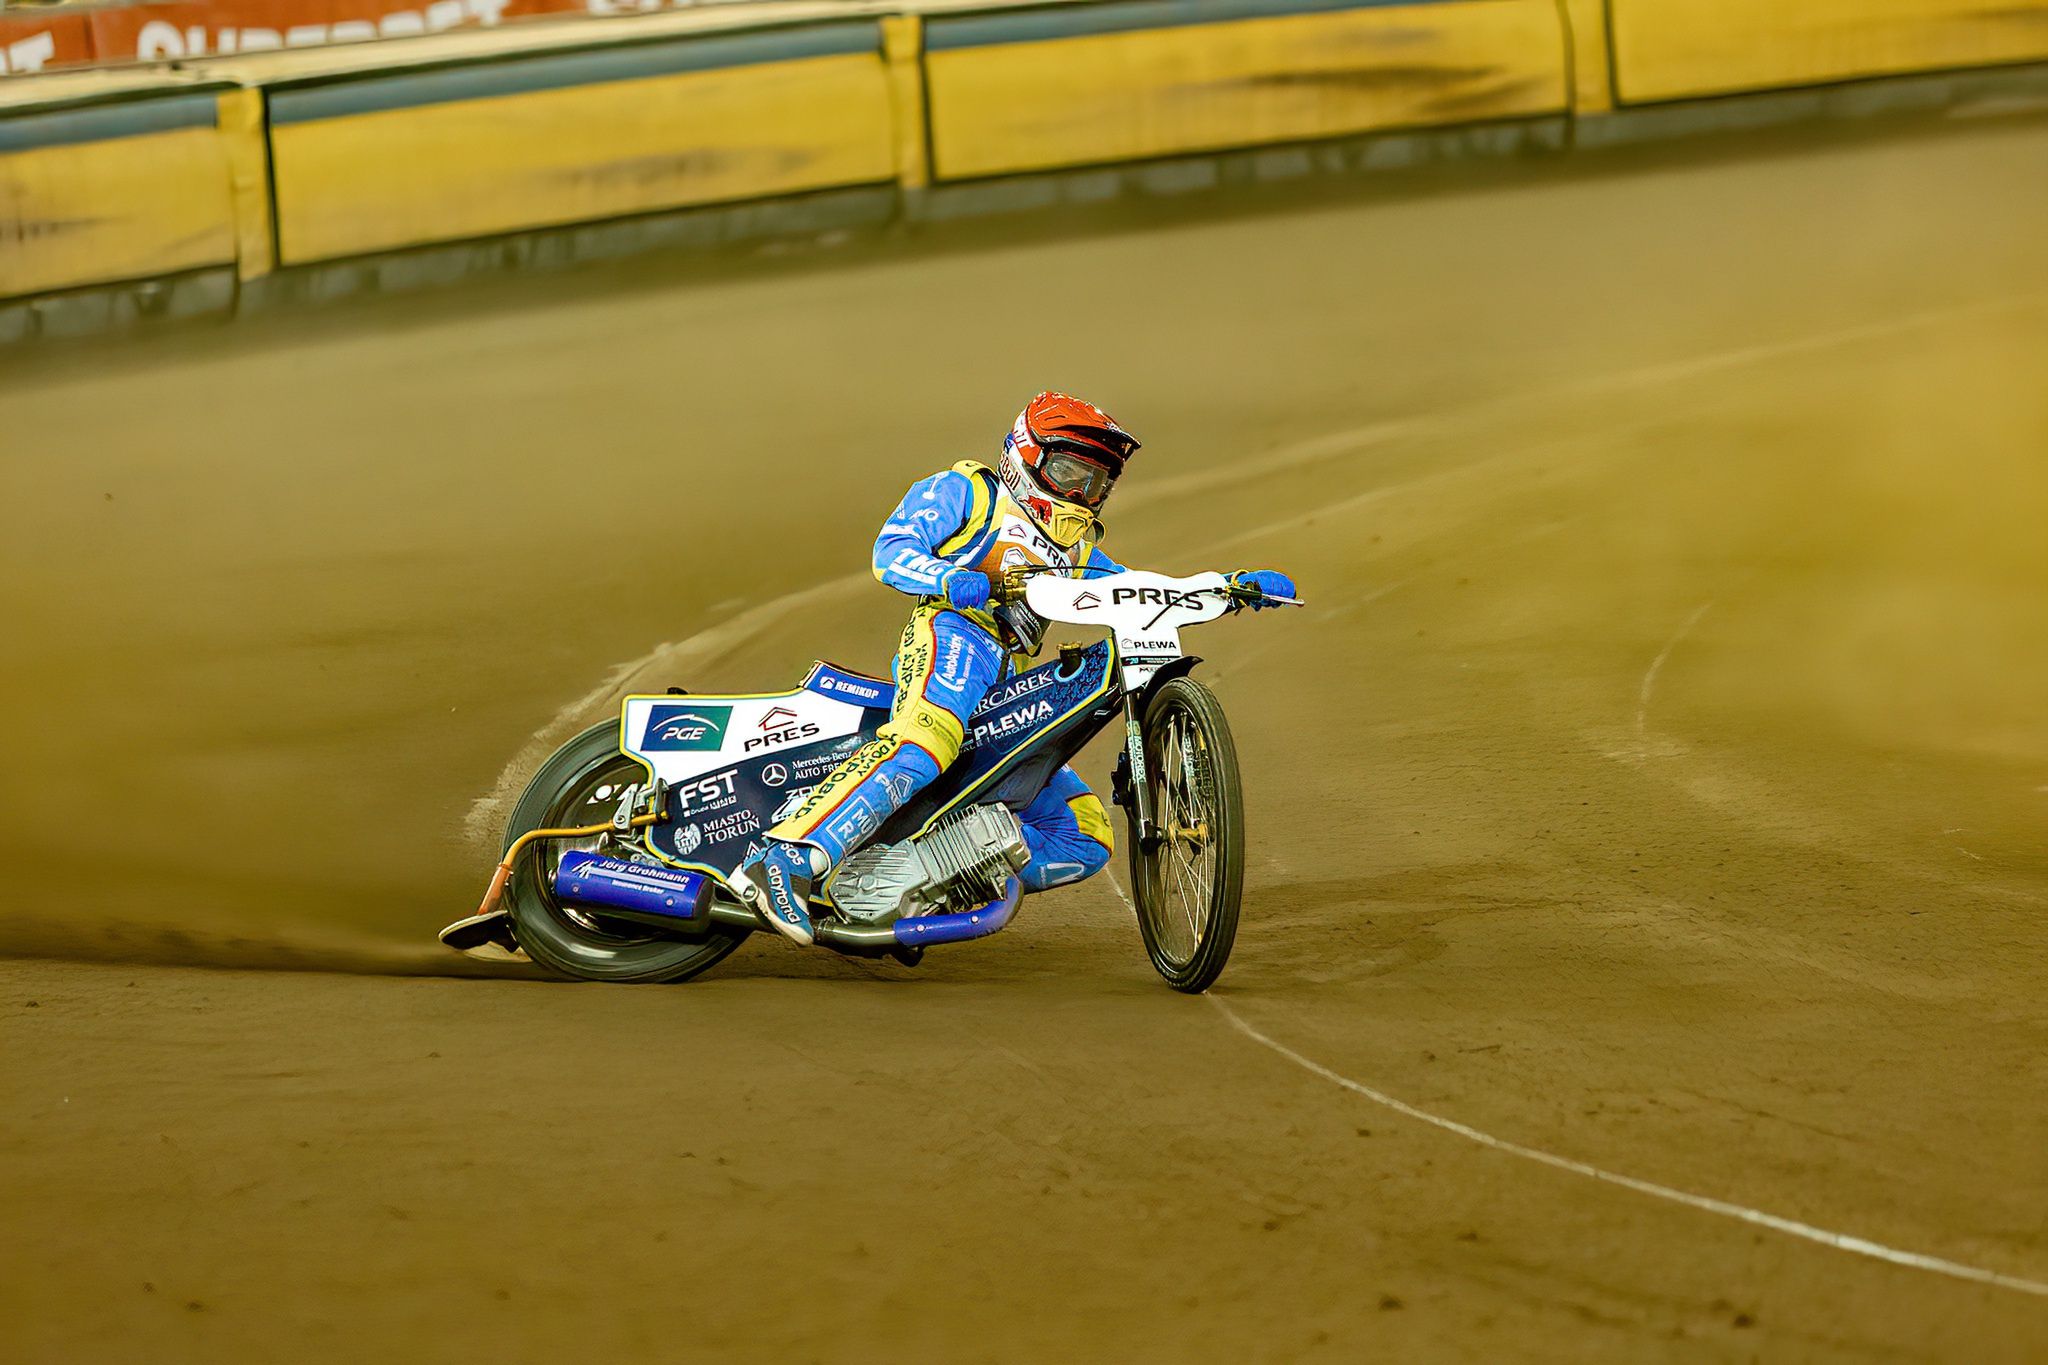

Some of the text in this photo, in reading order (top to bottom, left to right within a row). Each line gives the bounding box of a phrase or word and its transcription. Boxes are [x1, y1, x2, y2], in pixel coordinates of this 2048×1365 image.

[1112, 588, 1204, 611] PRES
[1133, 640, 1177, 650] PLEWA
[835, 681, 879, 699] REMIKOP
[974, 700, 1053, 741] PLEWA
[662, 727, 706, 741] PGE
[744, 722, 820, 752] PRES
[792, 751, 852, 769] Mercedes-Benz
[794, 762, 843, 780] AUTO FRE
[679, 769, 738, 809] FST
[702, 809, 752, 832] MIASTO
[704, 814, 760, 845] TORUŃ
[598, 859, 690, 884] Jörg Grohmann
[767, 864, 802, 924] daytona
